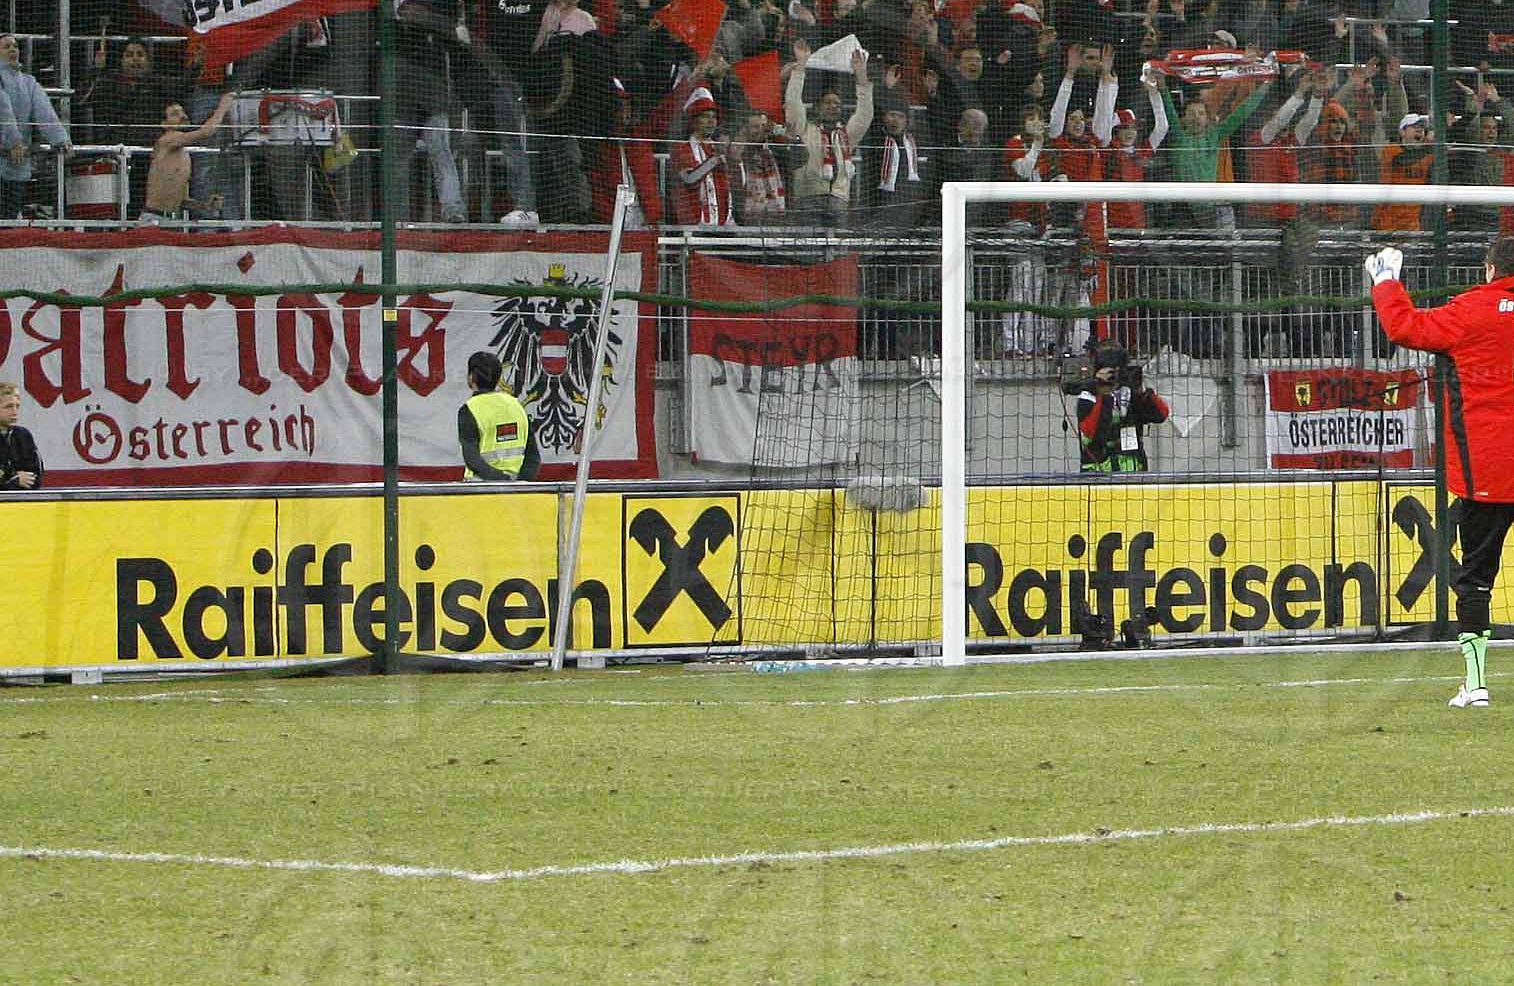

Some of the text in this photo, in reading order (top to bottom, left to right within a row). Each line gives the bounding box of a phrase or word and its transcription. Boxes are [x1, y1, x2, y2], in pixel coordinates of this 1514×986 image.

[0, 251, 454, 408] atriots
[72, 404, 316, 463] Österreich
[1289, 412, 1404, 448] ÖSTERREICHER
[116, 543, 612, 660] Raiffeisen
[964, 530, 1378, 638] Raiffeisen
